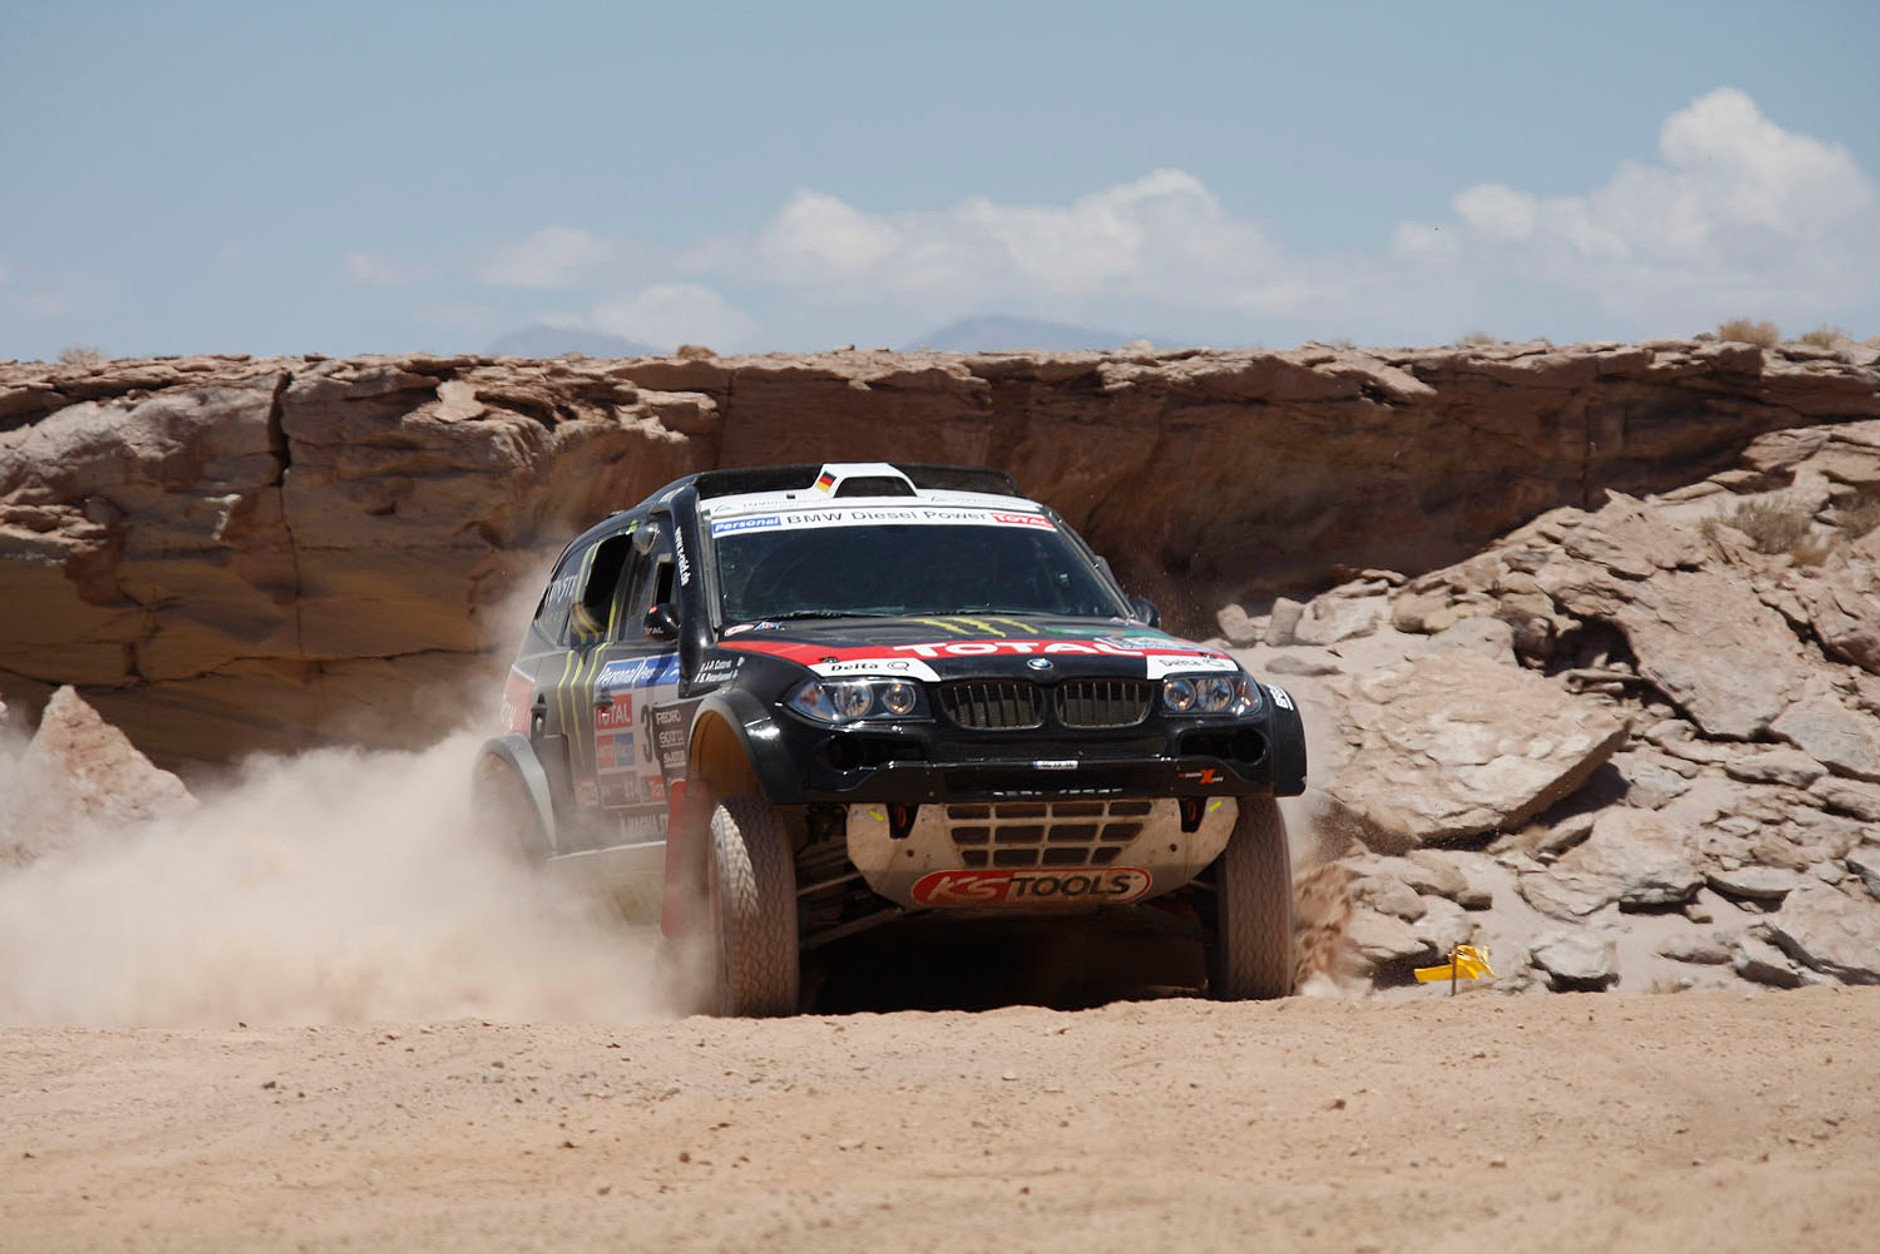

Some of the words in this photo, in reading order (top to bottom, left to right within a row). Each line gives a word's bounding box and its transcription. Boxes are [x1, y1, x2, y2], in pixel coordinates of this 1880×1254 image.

[787, 513, 842, 524] BMW
[852, 510, 917, 520] Diesel
[924, 511, 987, 520] Power
[993, 513, 1053, 528] TOTAL
[714, 517, 779, 533] Personal
[893, 642, 1144, 657] TOTAL
[599, 661, 642, 686] Personal
[831, 662, 879, 672] Delta
[927, 876, 1009, 901] KS
[1009, 875, 1130, 897] TOOLS
